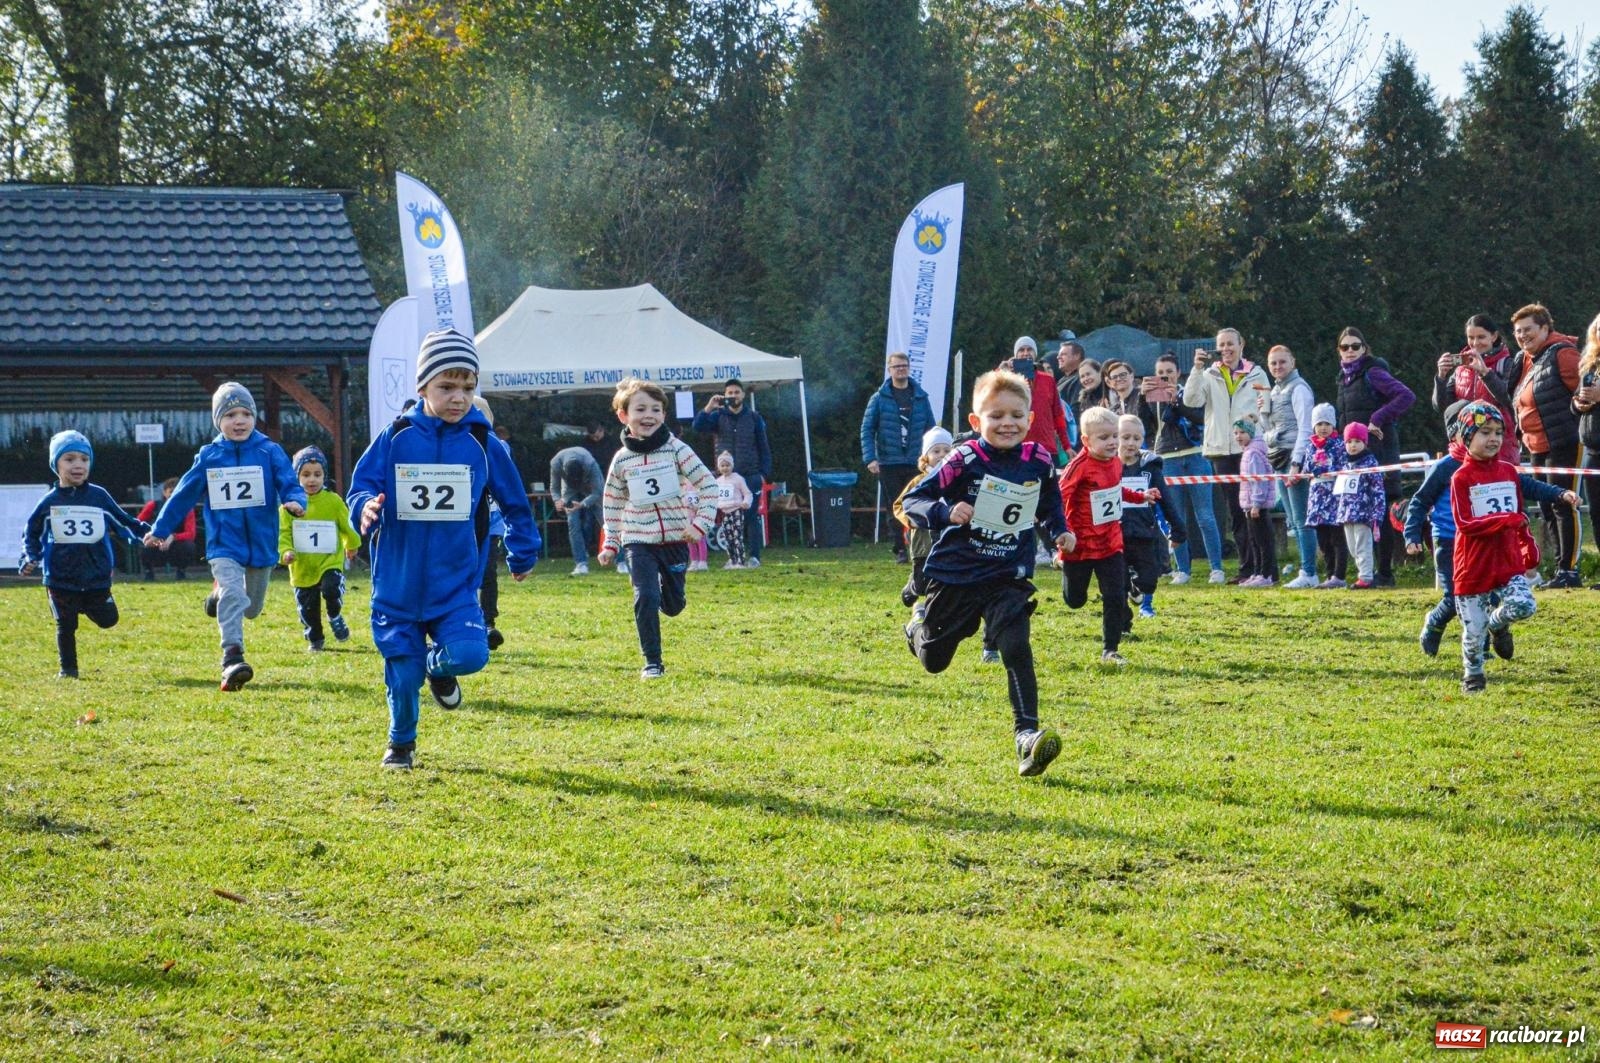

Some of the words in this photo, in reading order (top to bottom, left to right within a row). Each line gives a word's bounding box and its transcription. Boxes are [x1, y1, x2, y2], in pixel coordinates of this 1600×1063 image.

[428, 254, 453, 316] STOWARZYSZENIE
[914, 260, 937, 317] STOWARZYSZENIE
[910, 317, 929, 349] AKTYWNI
[908, 349, 926, 363] DLA
[493, 370, 575, 387] STOWARZYSZENIE
[584, 369, 623, 384] AKTYWNI
[632, 368, 651, 381] DLA
[659, 366, 704, 381] LEPSZEGO
[713, 365, 742, 379] JUTRA
[220, 481, 253, 501] 12
[411, 484, 455, 510] 32
[645, 478, 660, 496] 3
[1002, 503, 1023, 525] 6
[1486, 496, 1515, 514] 35
[63, 519, 94, 536] 33
[309, 532, 318, 547] 1
[976, 547, 1007, 557] GAWLIK
